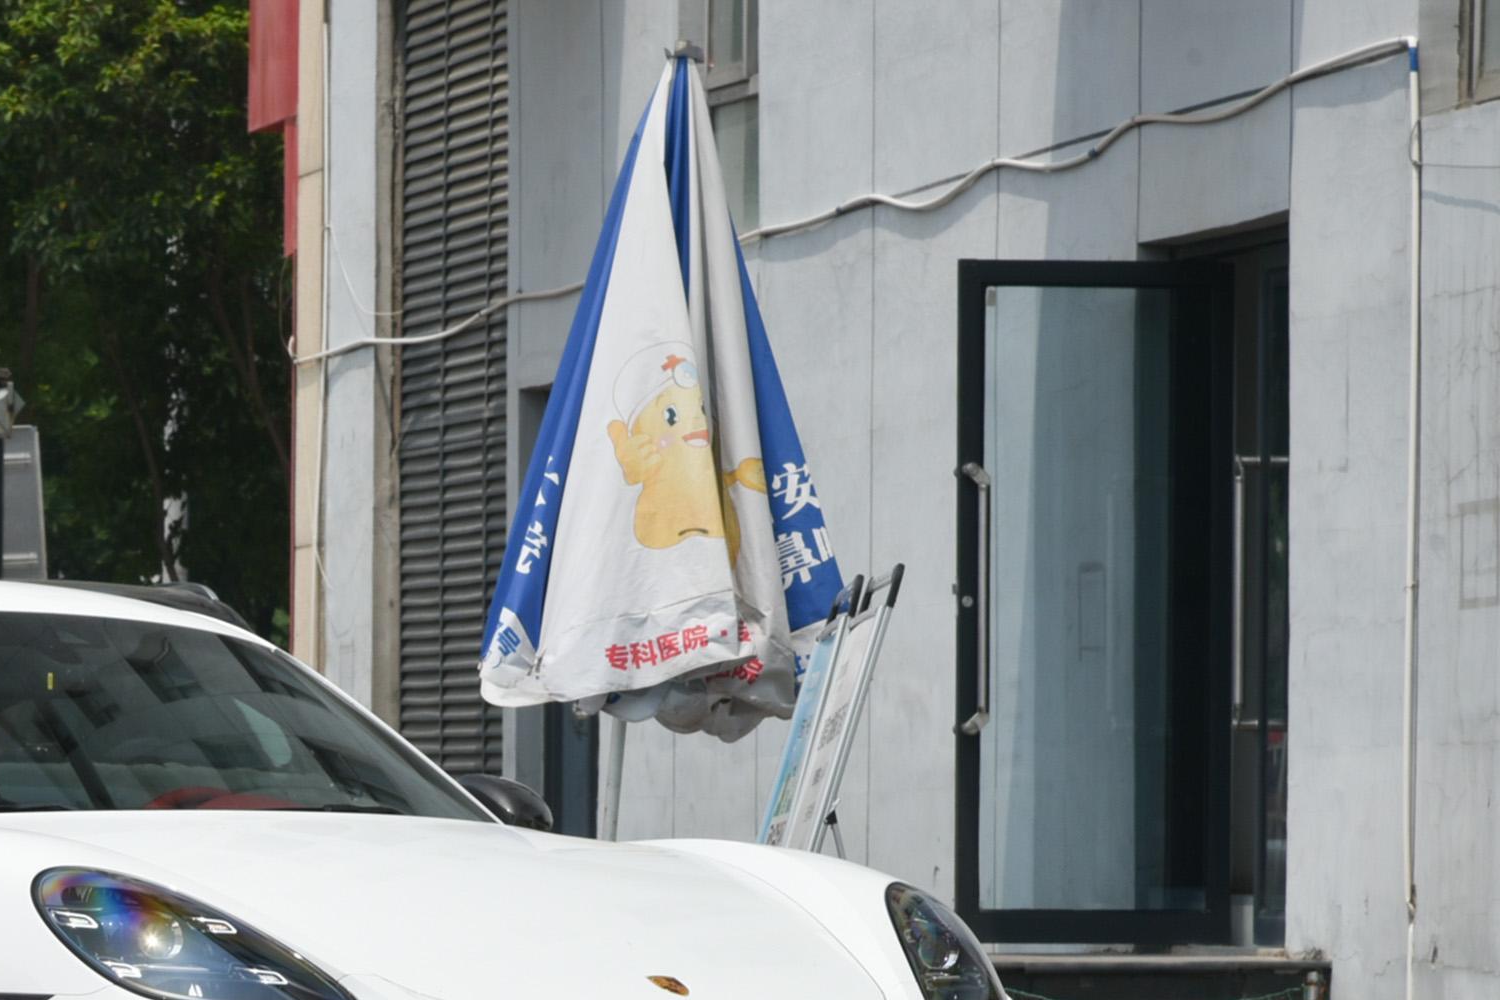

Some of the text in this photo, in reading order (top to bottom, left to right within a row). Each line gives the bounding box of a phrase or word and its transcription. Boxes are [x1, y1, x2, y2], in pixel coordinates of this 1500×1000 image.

[772, 462, 821, 520] 安
[605, 624, 709, 671] 专科医院
